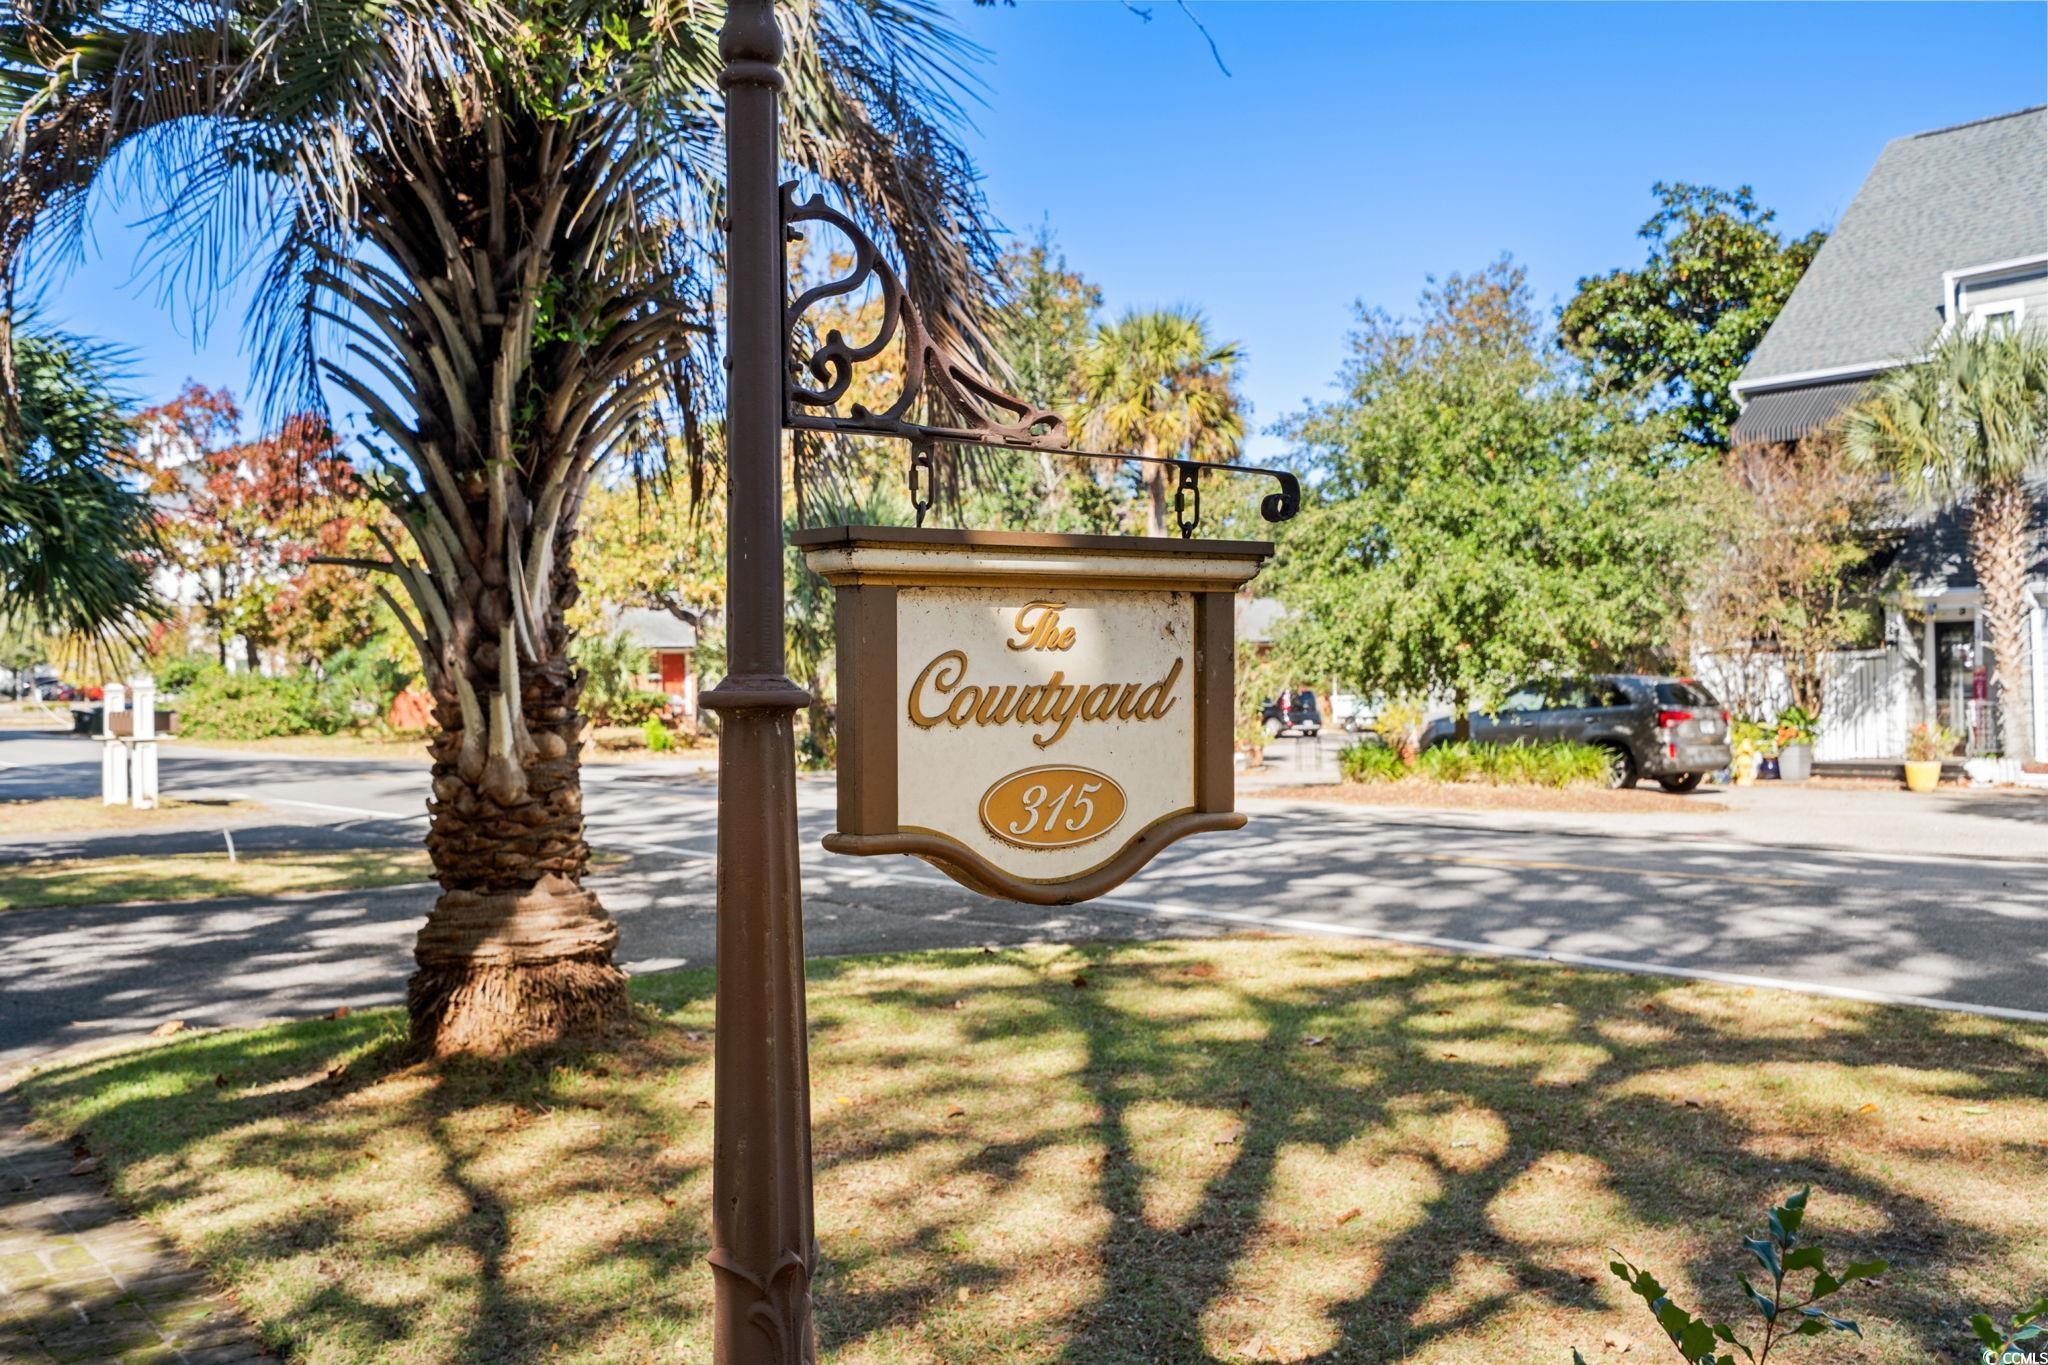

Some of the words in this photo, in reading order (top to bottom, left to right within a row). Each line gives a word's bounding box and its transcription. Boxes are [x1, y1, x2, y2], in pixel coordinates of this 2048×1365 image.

[1007, 600, 1077, 651] The
[908, 650, 1183, 747] Courtyard
[1009, 782, 1102, 835] 315
